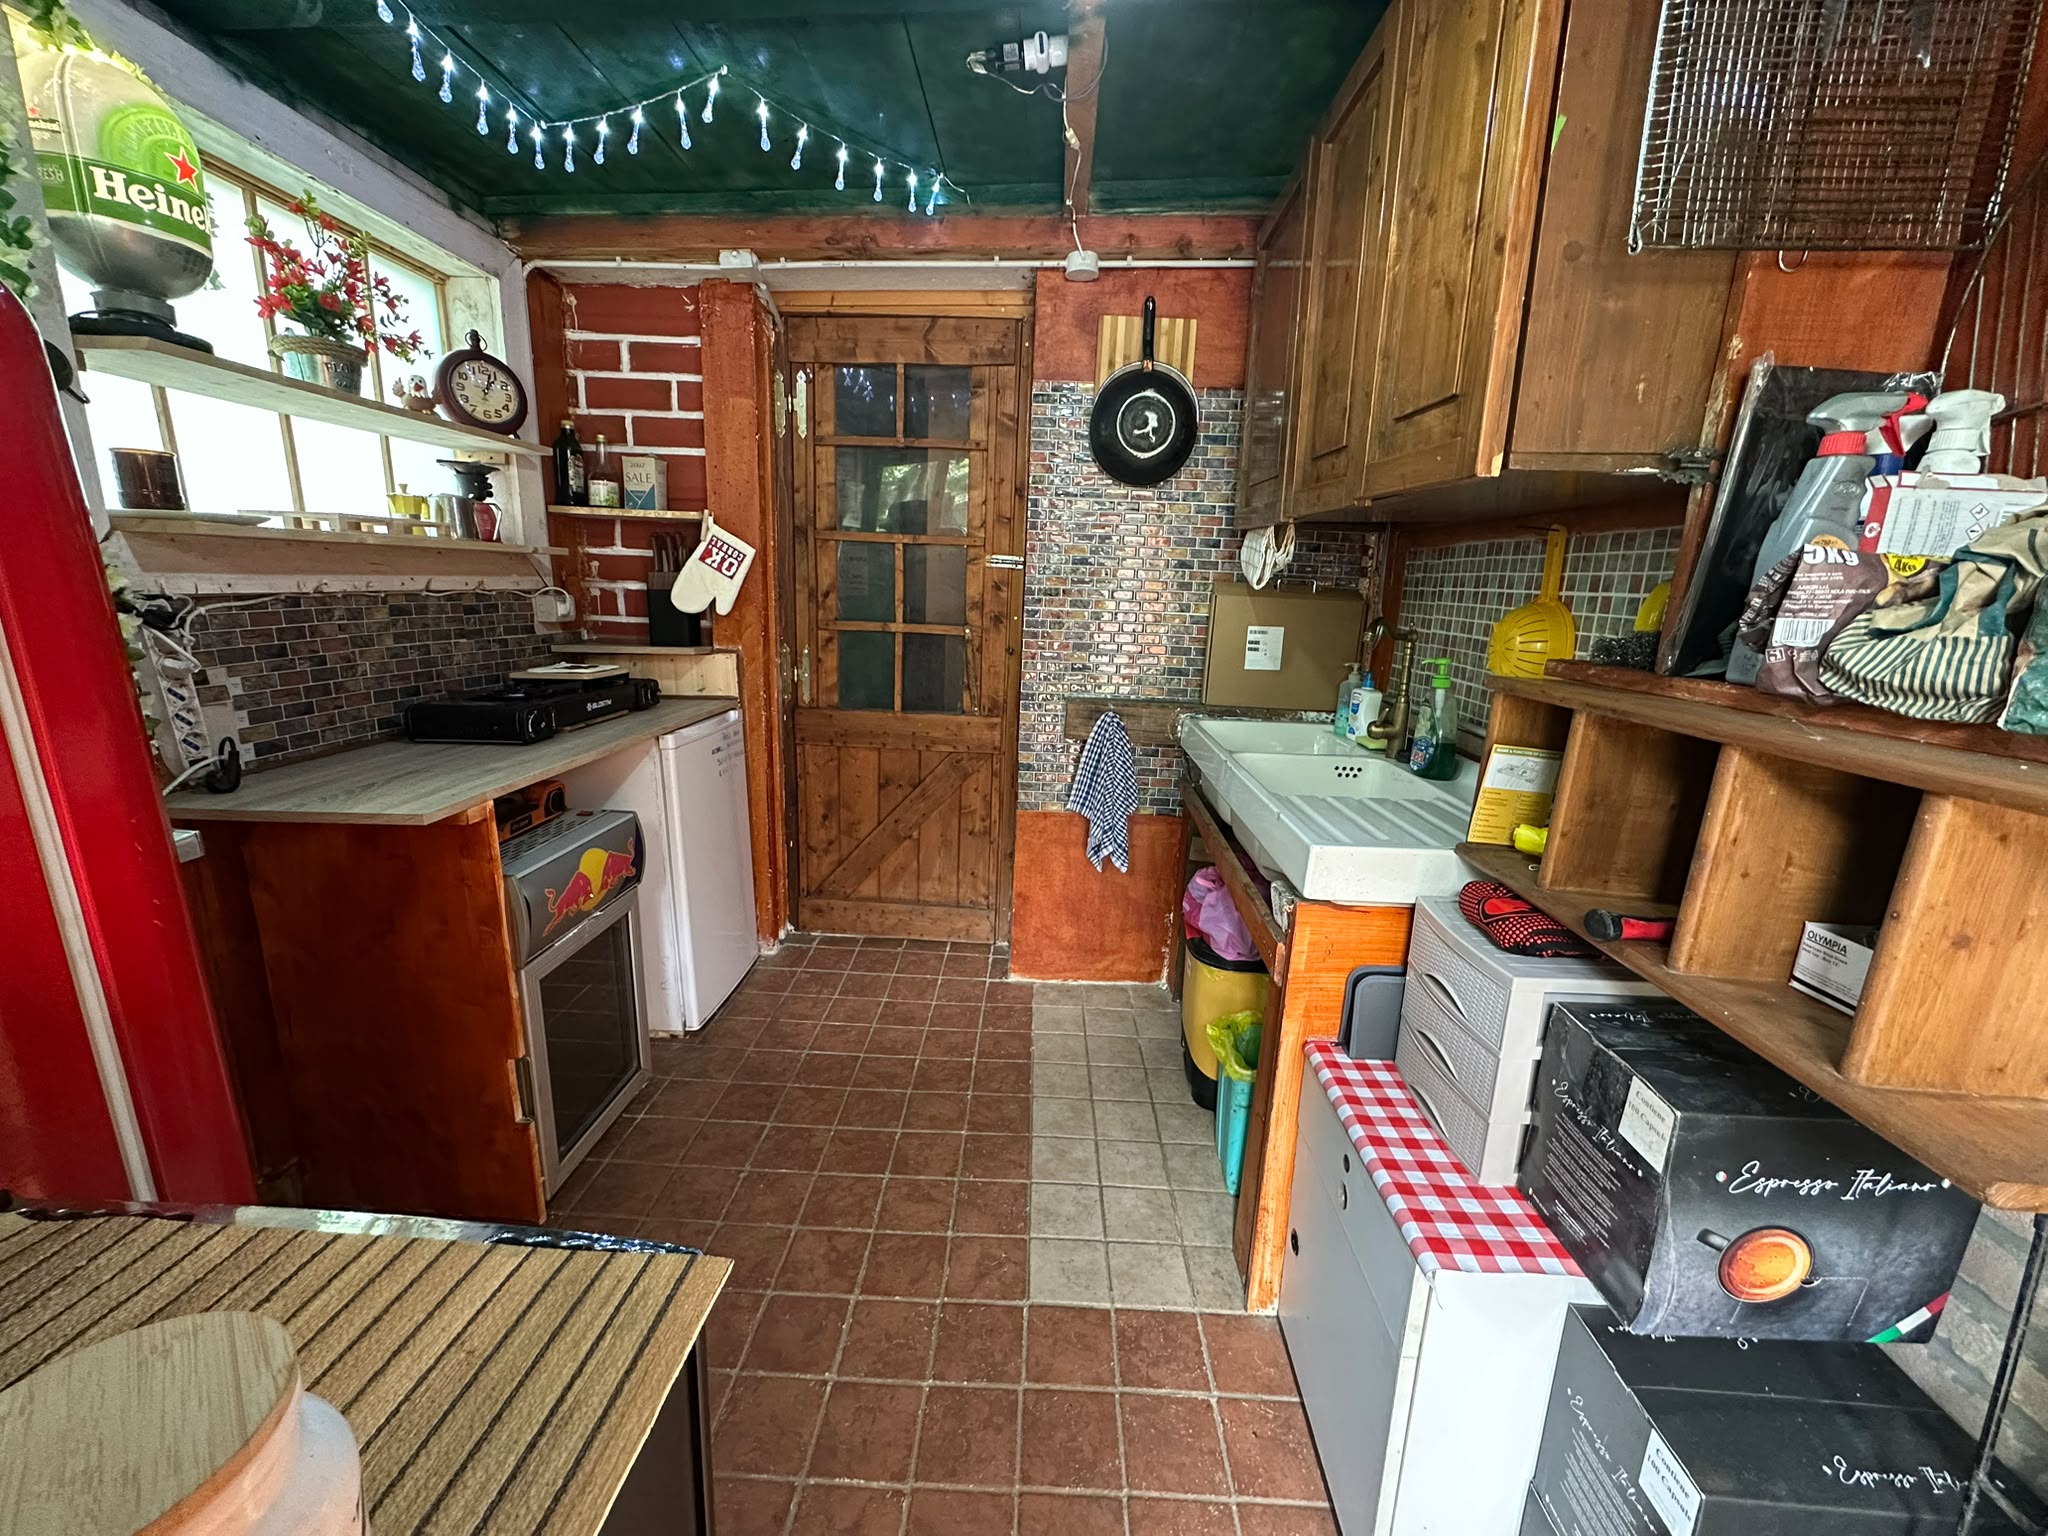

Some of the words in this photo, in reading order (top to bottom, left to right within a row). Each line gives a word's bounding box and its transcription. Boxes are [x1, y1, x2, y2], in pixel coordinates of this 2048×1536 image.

[469, 403, 478, 414] 7
[502, 403, 510, 413] 4
[504, 393, 512, 403] 3
[483, 409, 492, 419] 6
[494, 408, 503, 419] 5
[625, 471, 652, 484] SALE
[711, 536, 744, 562] CORRAL
[1807, 930, 1847, 955] OLYMPIA
[1636, 1090, 1667, 1123] Contiene
[1728, 1160, 1839, 1197] Espresso
[1840, 1168, 1937, 1201] Italiano
[1655, 1448, 1691, 1500] Contiene
[1833, 1455, 1918, 1489] Espresso
[1647, 1454, 1660, 1476] 100
[1661, 1475, 1692, 1523] Capsule
